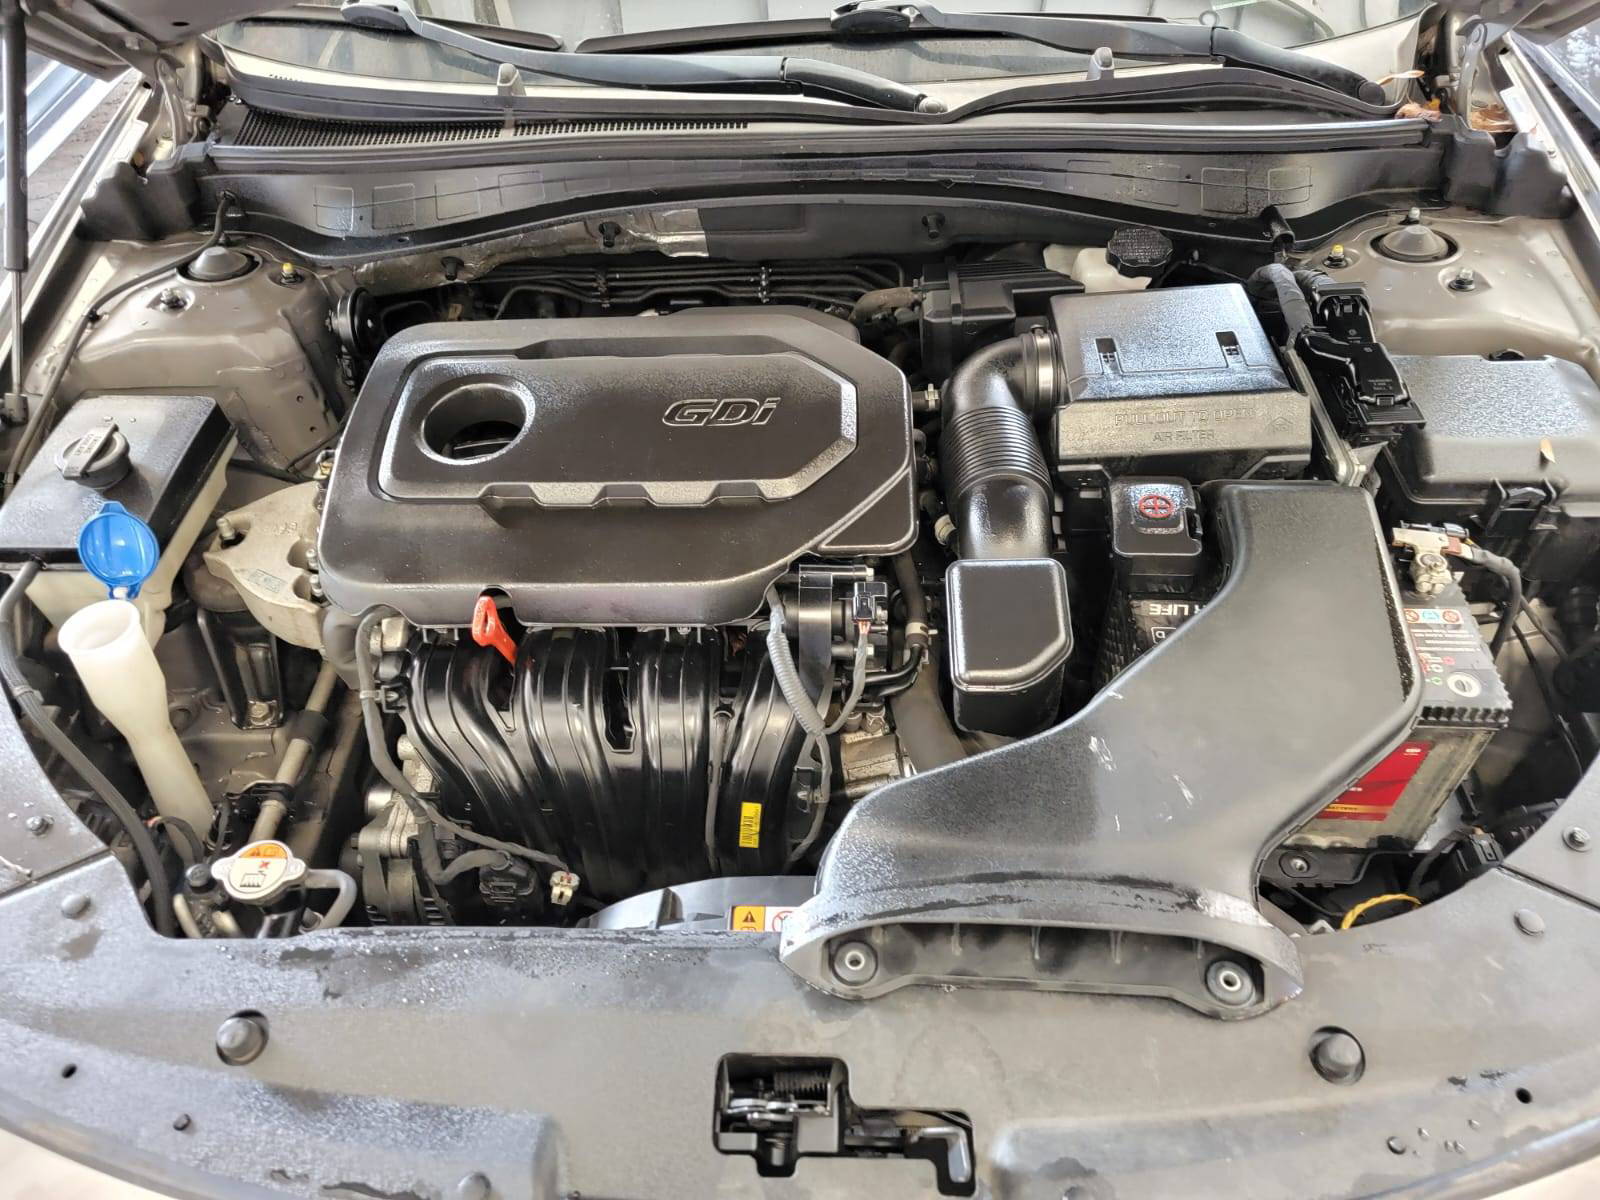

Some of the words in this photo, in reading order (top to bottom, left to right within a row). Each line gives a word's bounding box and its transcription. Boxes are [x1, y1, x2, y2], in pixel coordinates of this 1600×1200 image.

[662, 397, 781, 426] GDi
[1114, 413, 1153, 426] PULL
[1149, 603, 1189, 616] LIFE
